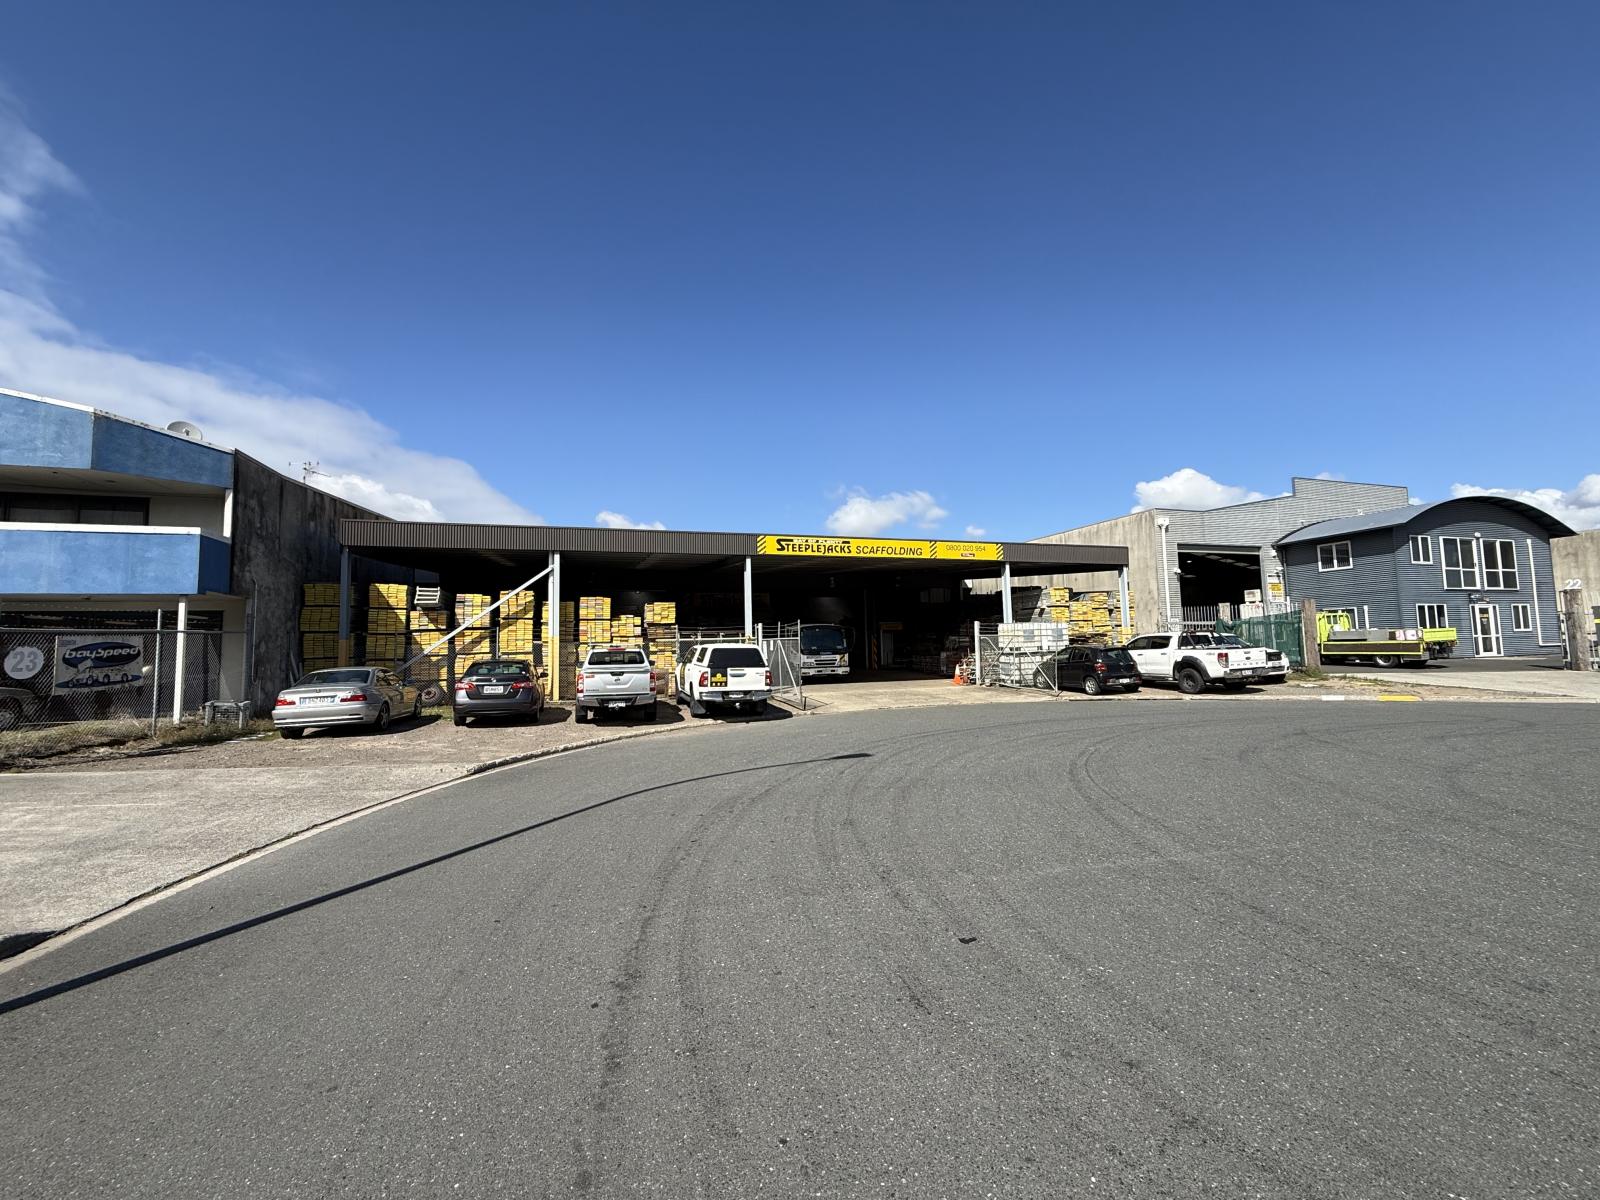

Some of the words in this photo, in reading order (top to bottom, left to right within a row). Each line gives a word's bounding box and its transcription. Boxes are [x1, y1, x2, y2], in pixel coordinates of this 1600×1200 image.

[776, 538, 851, 554] STEEPLEJACKS
[855, 545, 923, 556] SCAFFOLDING
[1564, 578, 1582, 589] 22
[10, 650, 38, 672] 23
